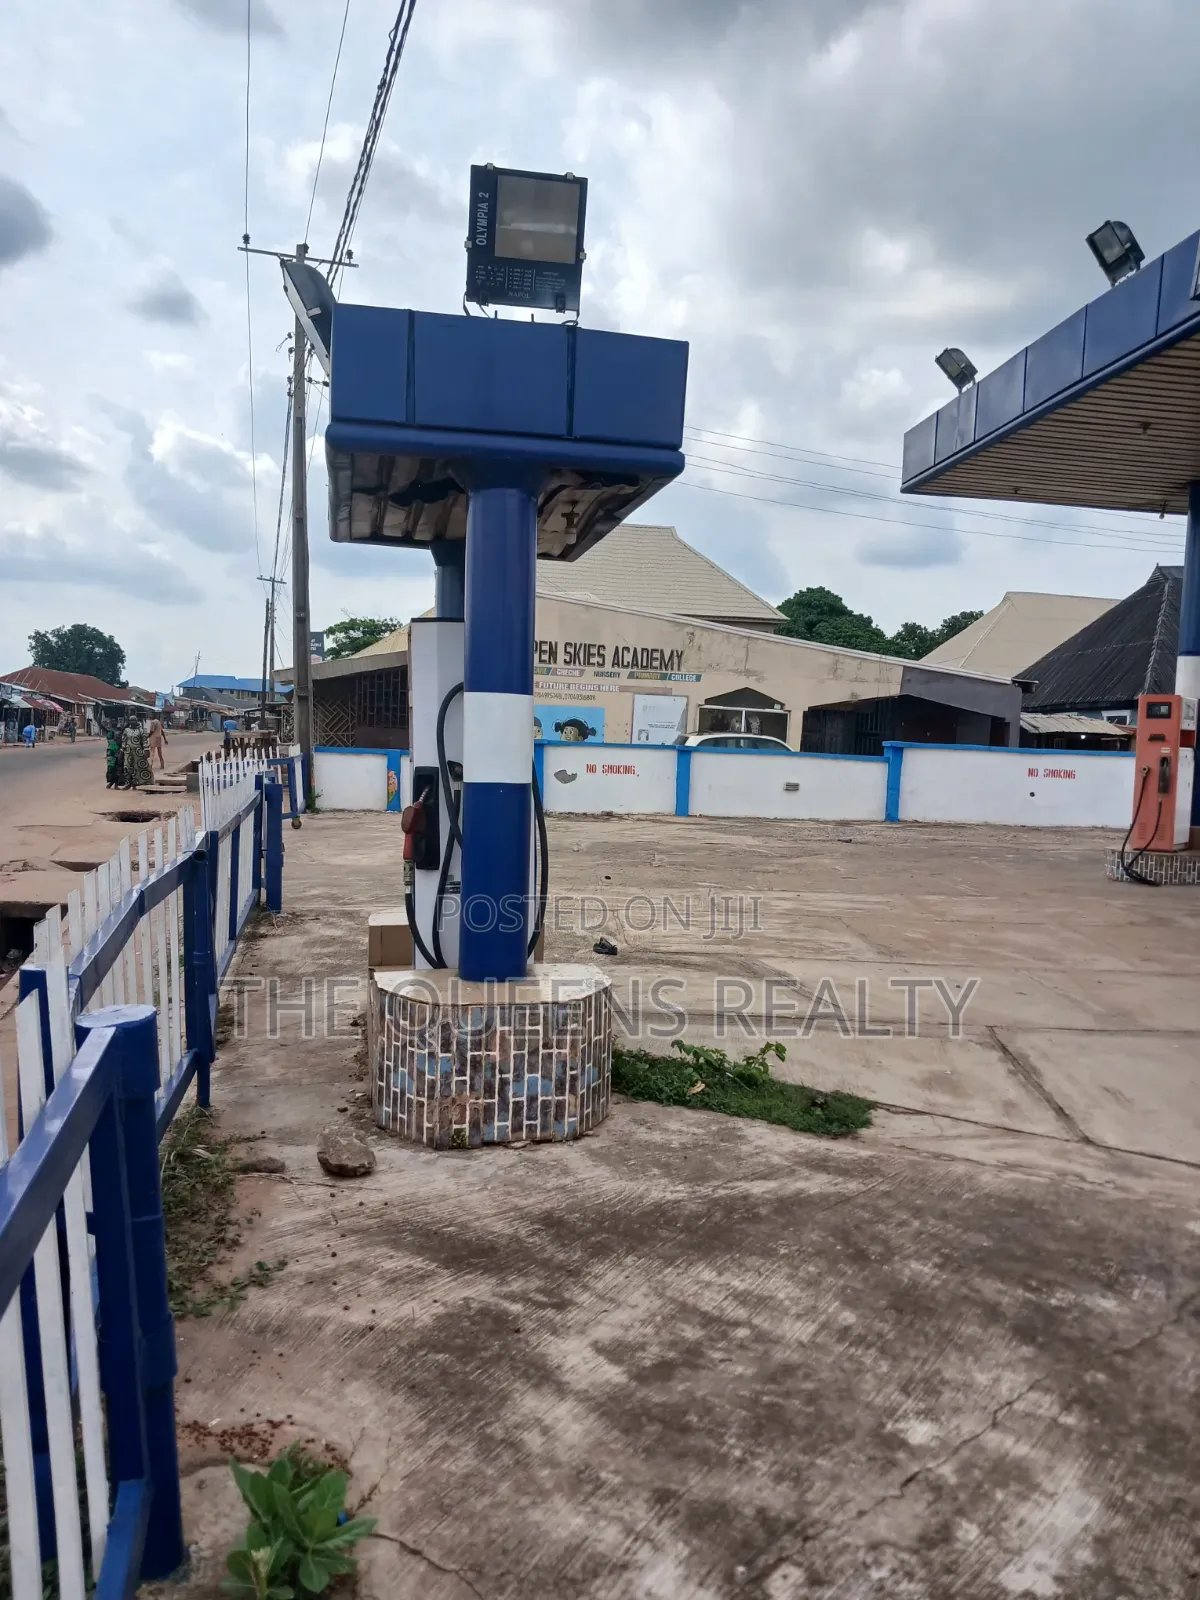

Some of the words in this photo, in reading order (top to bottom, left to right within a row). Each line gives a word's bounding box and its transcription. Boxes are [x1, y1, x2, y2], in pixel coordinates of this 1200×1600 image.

[476, 203, 489, 246] OLYMPIA
[563, 642, 606, 668] SKIES
[611, 646, 684, 672] ACADEMY
[593, 671, 621, 679] NURSERY
[671, 673, 697, 682] COLLEGE
[539, 681, 569, 690] FUTURE
[569, 683, 599, 691] BEGINS
[600, 684, 620, 692] HERE
[586, 763, 597, 774] NO
[602, 764, 636, 775] SMOKING
[1028, 767, 1039, 778] NO
[1043, 768, 1076, 780] SMOKING
